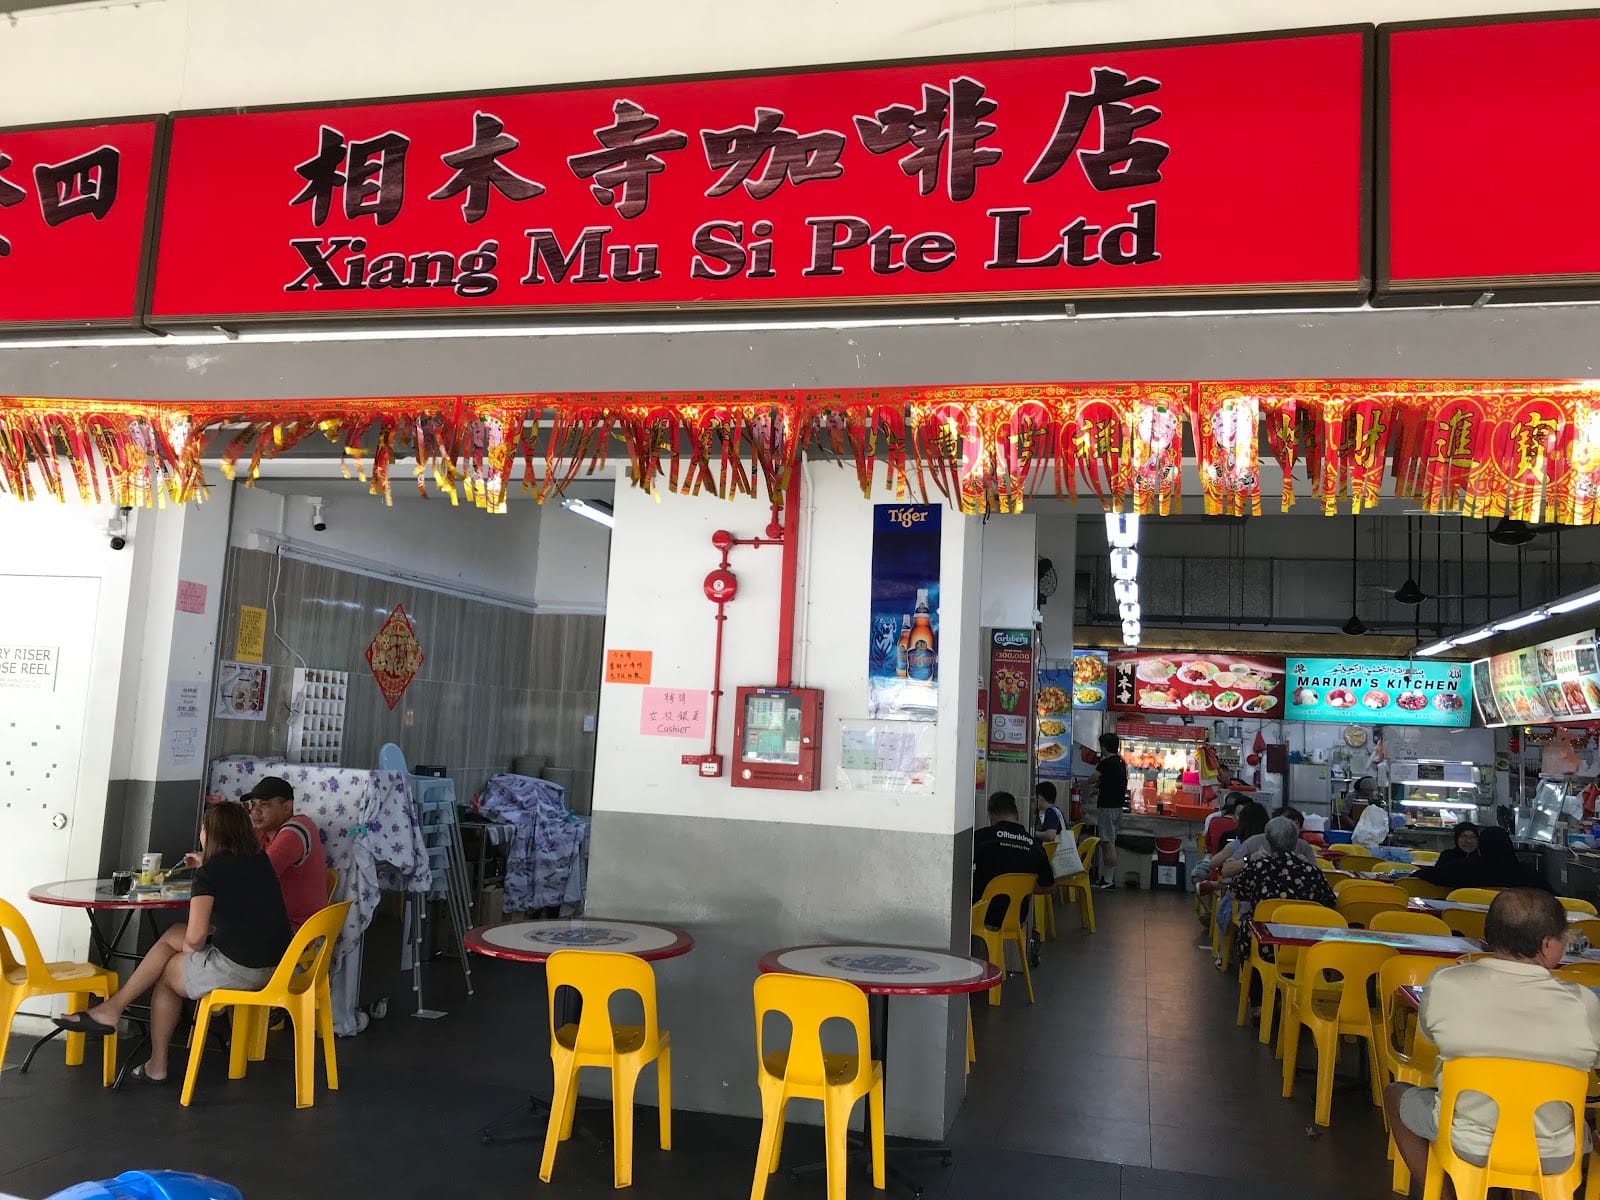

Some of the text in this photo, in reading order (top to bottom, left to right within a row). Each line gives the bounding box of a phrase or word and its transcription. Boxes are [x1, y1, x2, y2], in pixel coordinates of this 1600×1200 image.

[289, 67, 1170, 226] 相木寺咖啡店
[284, 201, 1161, 297] Xiang Mu Si Pte Ltd
[888, 508, 928, 528] Tiger
[994, 632, 1029, 646] Carlsberg
[15, 649, 51, 661] RISER
[21, 662, 51, 676] REEL
[1116, 661, 1133, 704] 相木寺
[1297, 676, 1459, 691] MARIAM'S KITCHEN
[656, 723, 691, 734] Cashier
